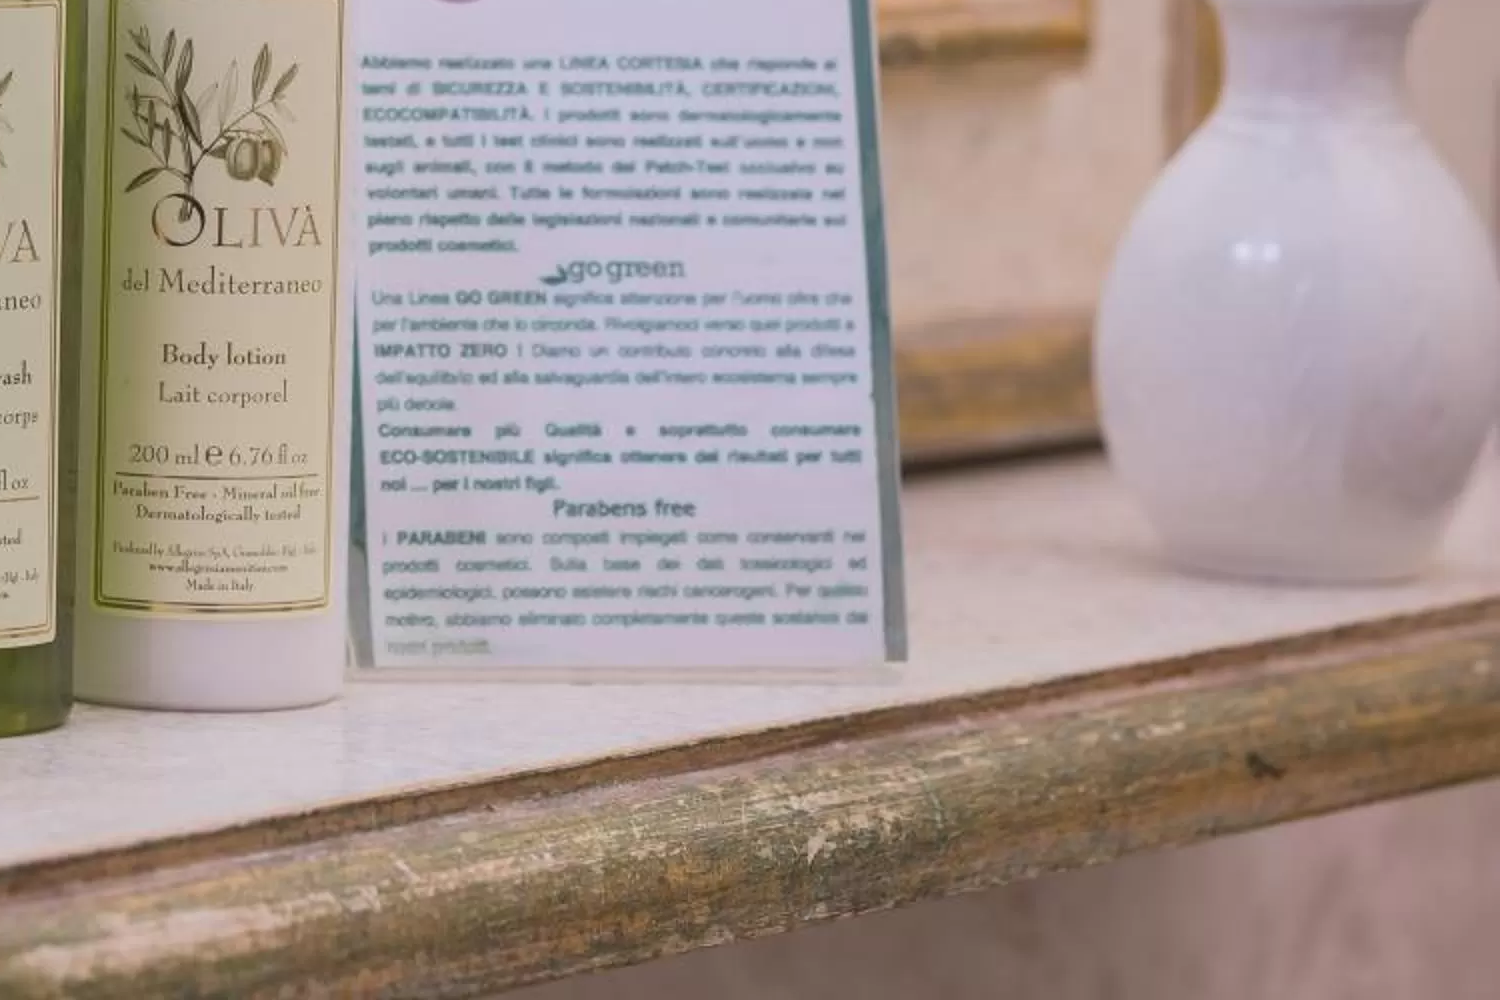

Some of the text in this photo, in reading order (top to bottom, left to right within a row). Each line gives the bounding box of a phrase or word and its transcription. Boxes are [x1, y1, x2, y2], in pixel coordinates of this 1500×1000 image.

[122, 265, 323, 296] del Mediterraneo
[568, 260, 686, 284] go green
[162, 342, 285, 370] Body lotion
[159, 378, 288, 408] Lait corporel
[129, 444, 170, 465] 200
[175, 444, 199, 464] ml
[229, 446, 273, 466] 6.76
[277, 443, 288, 464] fl
[292, 453, 308, 464] oz
[12, 478, 28, 490] oz
[113, 480, 169, 498] Paraben
[174, 485, 206, 500] Free
[223, 483, 277, 500] Mineral
[135, 504, 300, 524] Dermatologically tested
[553, 498, 696, 518] Parabens free
[186, 578, 215, 592] Made
[231, 578, 254, 593] Italy
